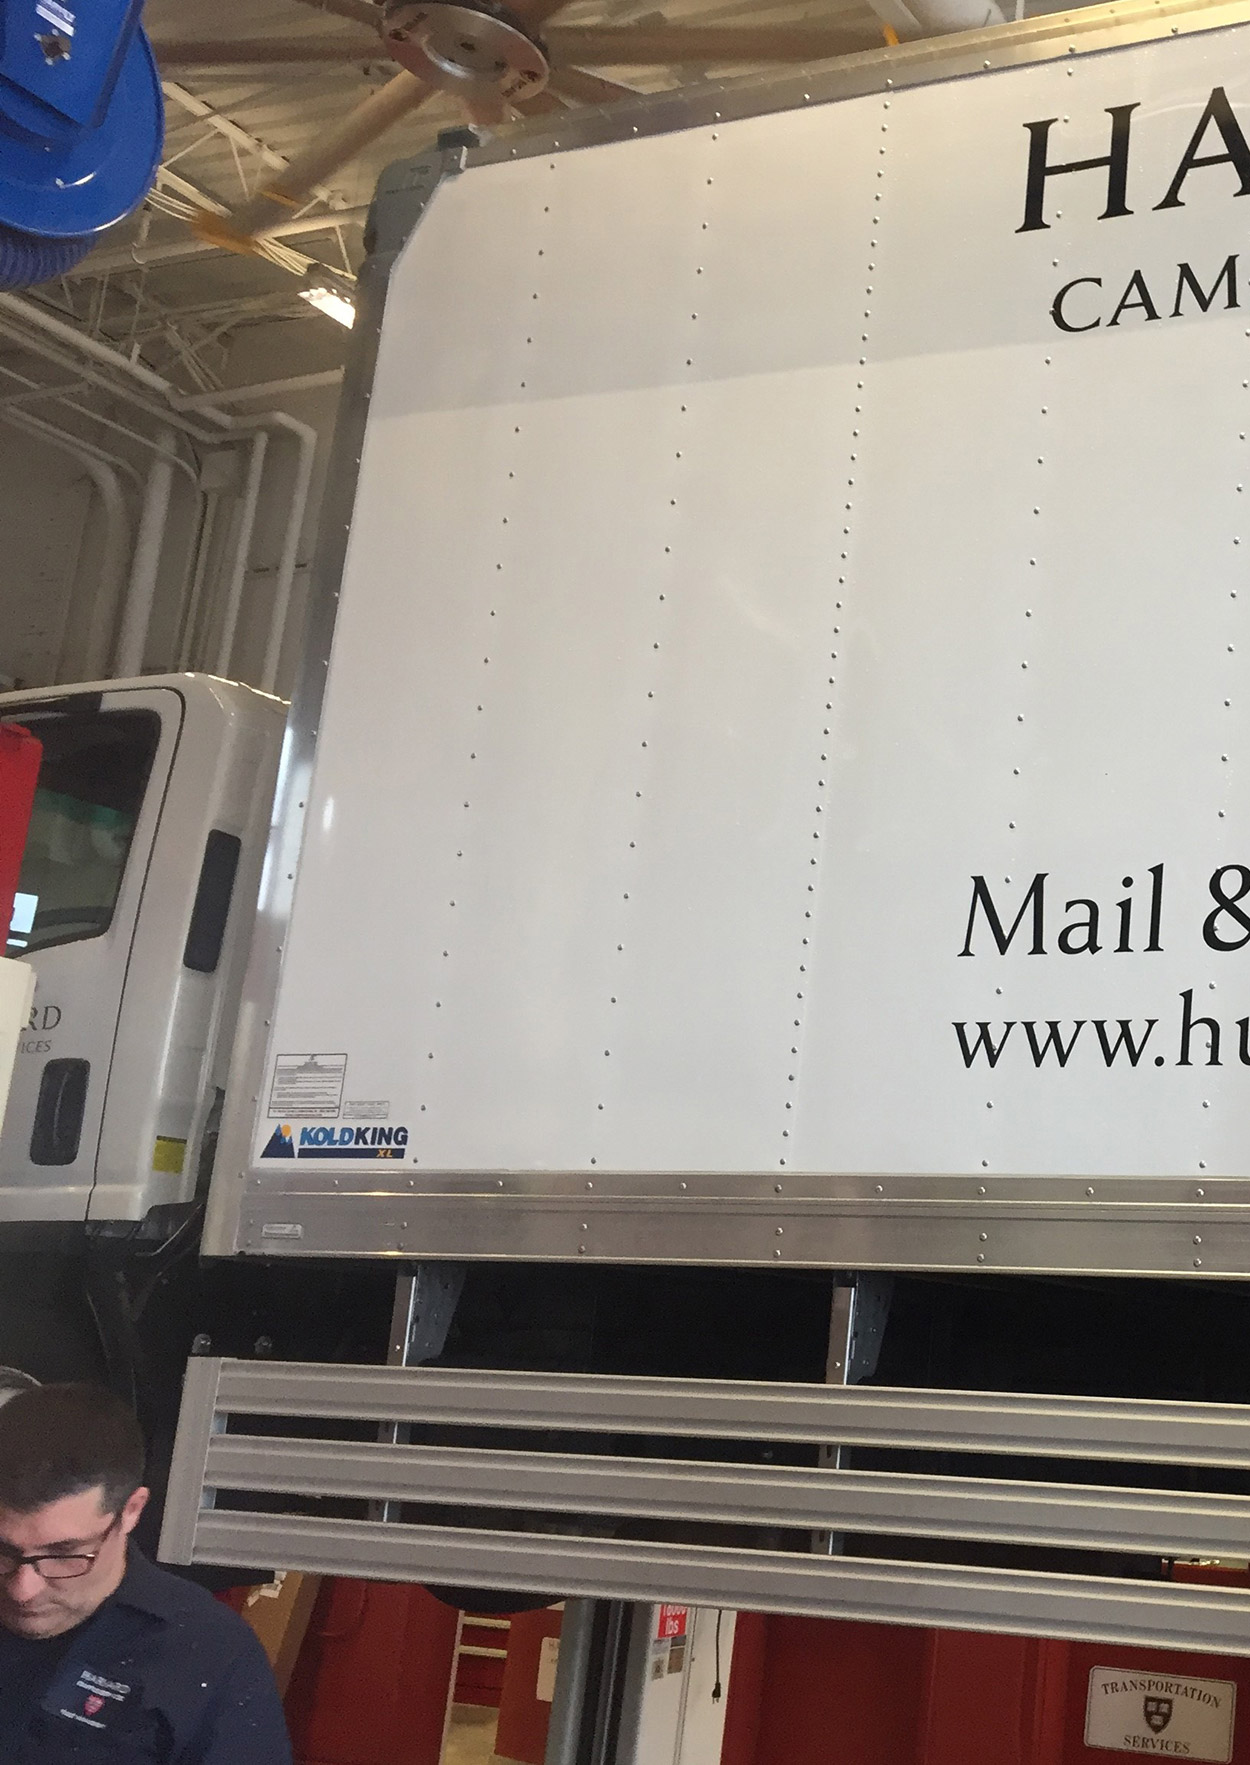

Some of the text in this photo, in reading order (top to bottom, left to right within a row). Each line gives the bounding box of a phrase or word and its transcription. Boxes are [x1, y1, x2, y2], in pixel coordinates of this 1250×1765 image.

[957, 862, 1164, 957] Mail
[299, 1126, 409, 1146] KOLDKING
[376, 1149, 394, 1158] XL
[1101, 1679, 1221, 1708] TRANSPORTATION
[1123, 1735, 1190, 1754] SERVICES
